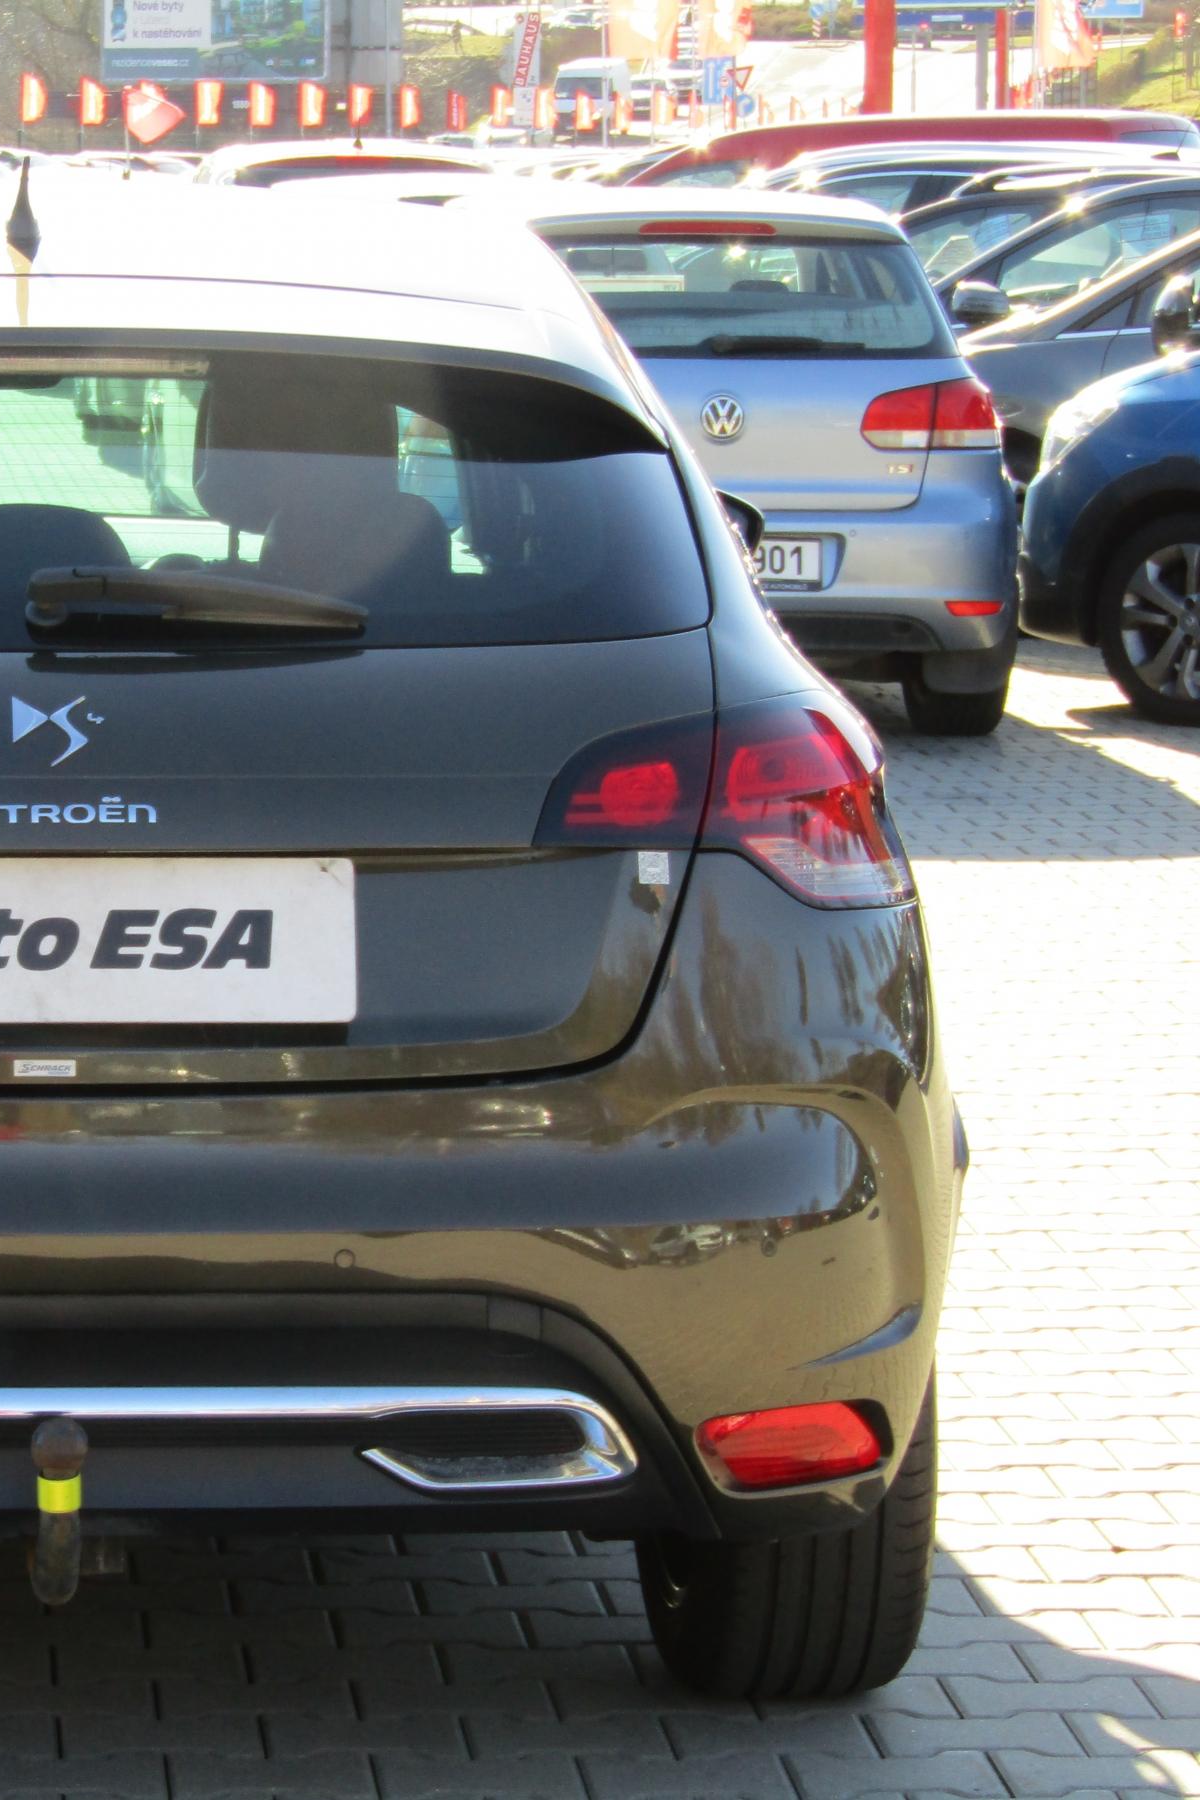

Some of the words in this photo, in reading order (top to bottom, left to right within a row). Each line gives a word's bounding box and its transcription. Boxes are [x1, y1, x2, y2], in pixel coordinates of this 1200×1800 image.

[162, 0, 184, 12] byty
[514, 13, 539, 86] BAUHAUS
[89, 908, 274, 971] ESA
